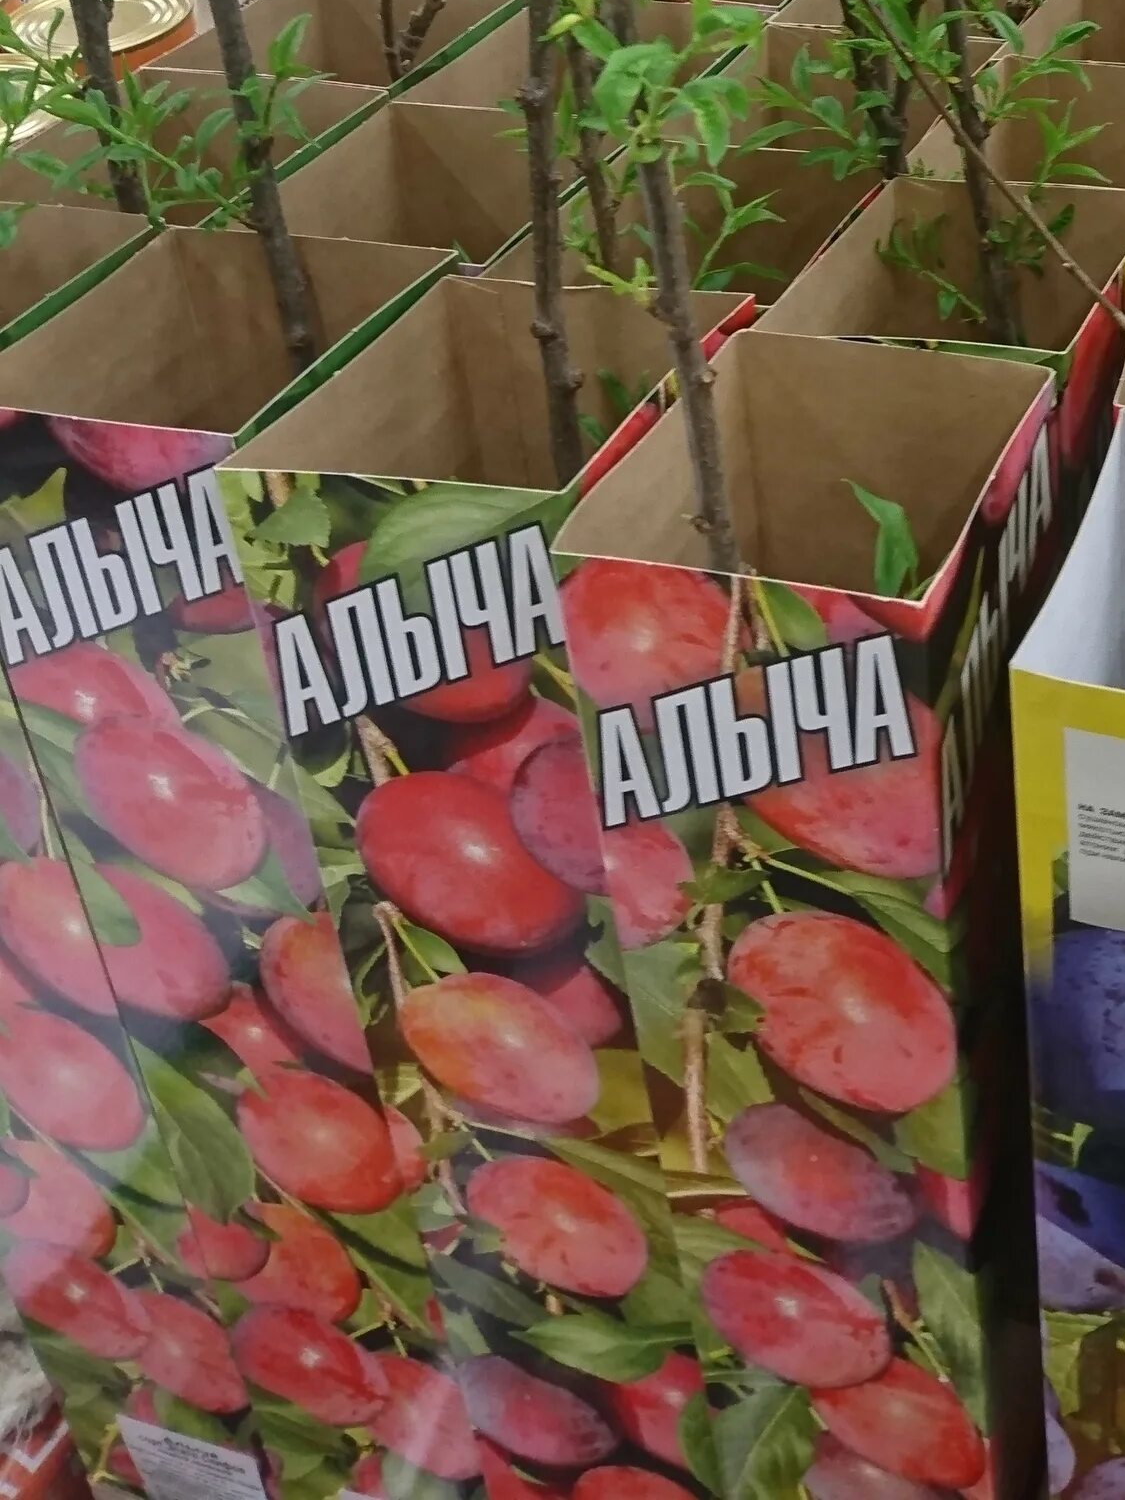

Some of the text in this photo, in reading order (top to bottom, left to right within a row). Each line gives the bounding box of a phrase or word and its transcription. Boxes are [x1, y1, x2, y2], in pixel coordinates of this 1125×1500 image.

[0, 464, 246, 666] АЛЫЧА
[273, 522, 567, 738] АЛЫЧА
[600, 633, 917, 829] АЛЫЧА
